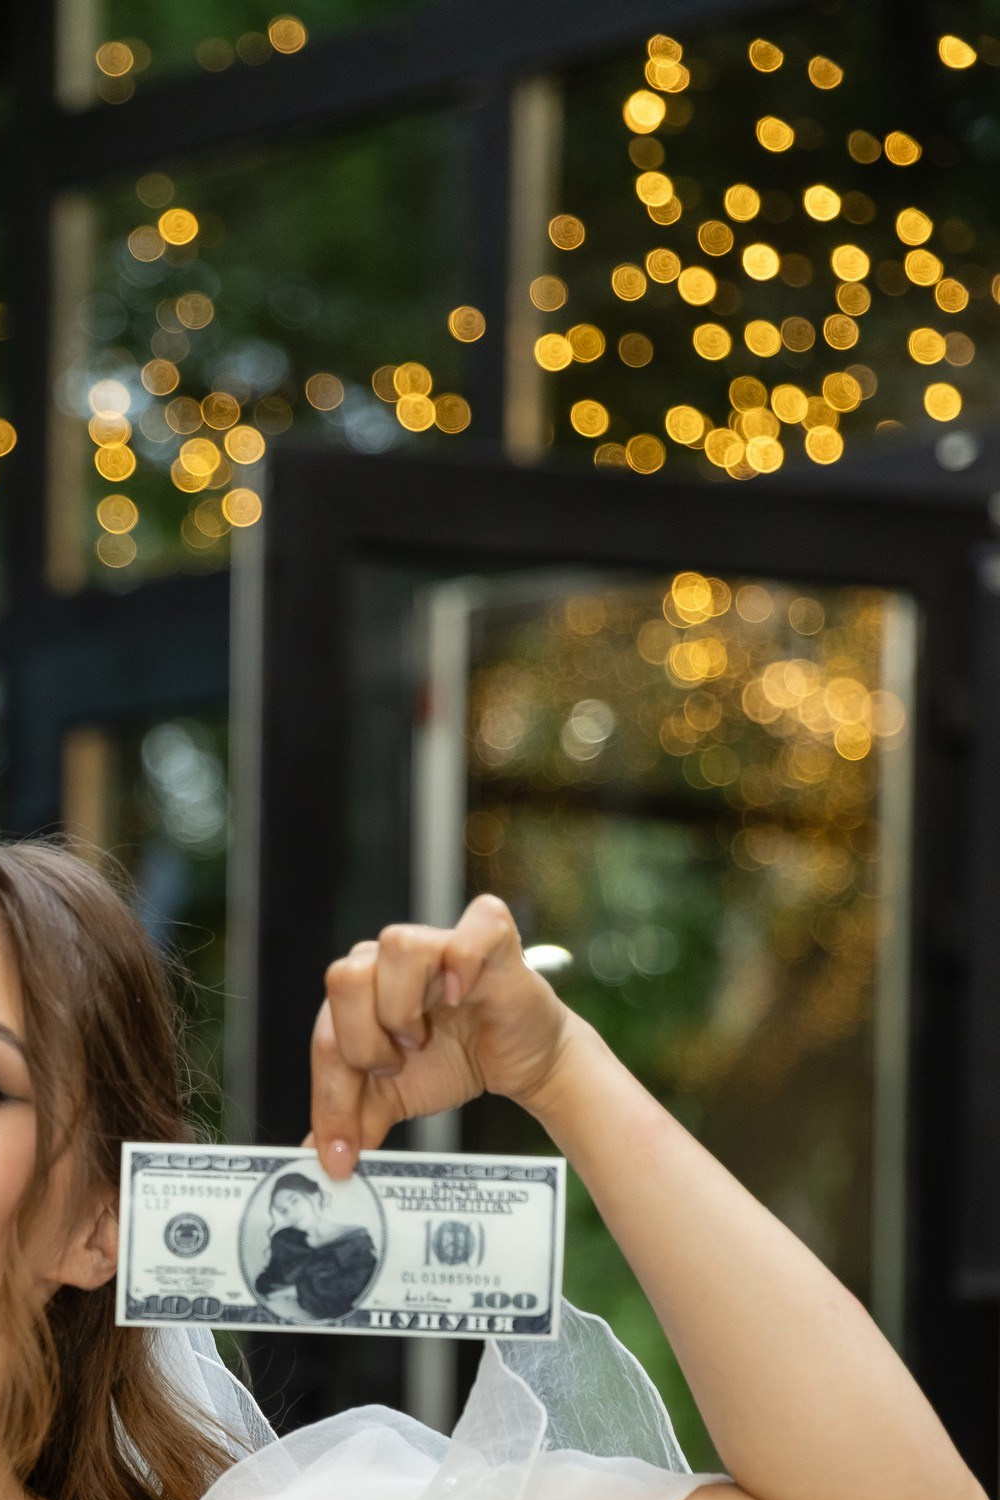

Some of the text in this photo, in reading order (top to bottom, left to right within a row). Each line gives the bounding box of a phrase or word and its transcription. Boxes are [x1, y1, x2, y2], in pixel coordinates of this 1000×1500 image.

[137, 1153, 252, 1171] 100
[445, 1164, 549, 1181] 100
[142, 1295, 224, 1320] 100
[471, 1291, 539, 1309] 100
